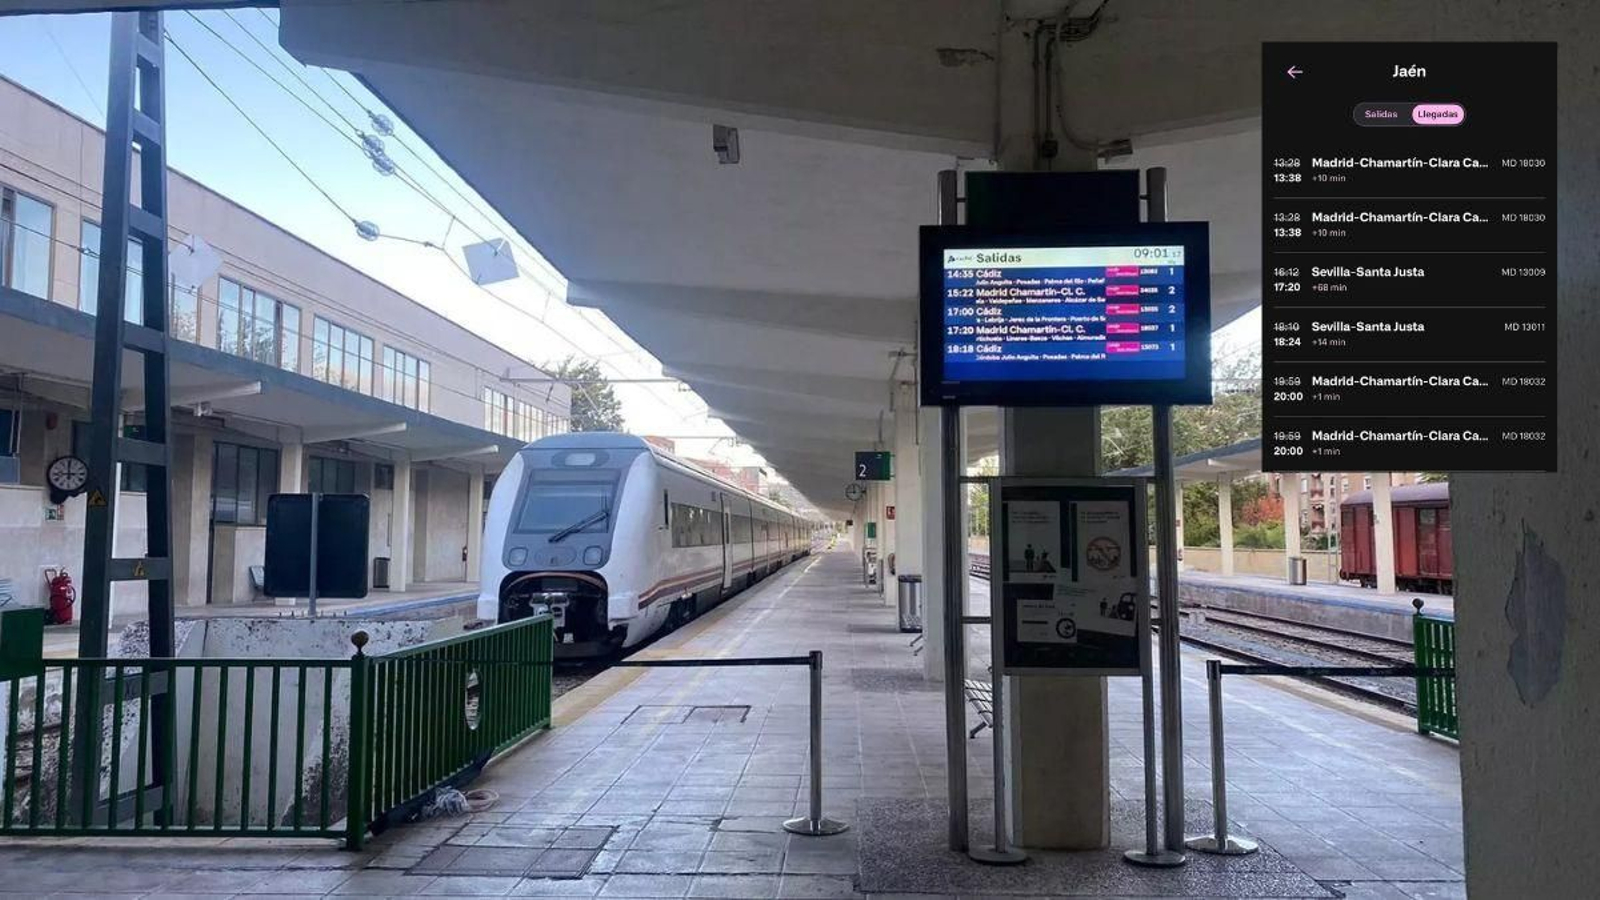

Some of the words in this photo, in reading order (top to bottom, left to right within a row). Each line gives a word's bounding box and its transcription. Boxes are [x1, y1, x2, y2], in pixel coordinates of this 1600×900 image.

[977, 252, 1022, 263] Salidas
[1134, 248, 1168, 258] 09:01
[947, 270, 974, 278] 14:35
[976, 269, 1002, 278] Cádiz
[1169, 267, 1174, 276] 1
[947, 288, 974, 297] 15:22
[976, 288, 1008, 297] Madrid
[1168, 286, 1176, 295] 2
[947, 307, 974, 316] 17:00
[976, 307, 1002, 316] Cádiz
[1168, 305, 1176, 314] 2
[947, 326, 974, 335] 17:20
[976, 325, 1008, 334] Madrid
[1170, 324, 1176, 333] 1
[976, 344, 1002, 353] Cádiz
[1170, 343, 1175, 352] 1
[859, 464, 867, 477] 2
